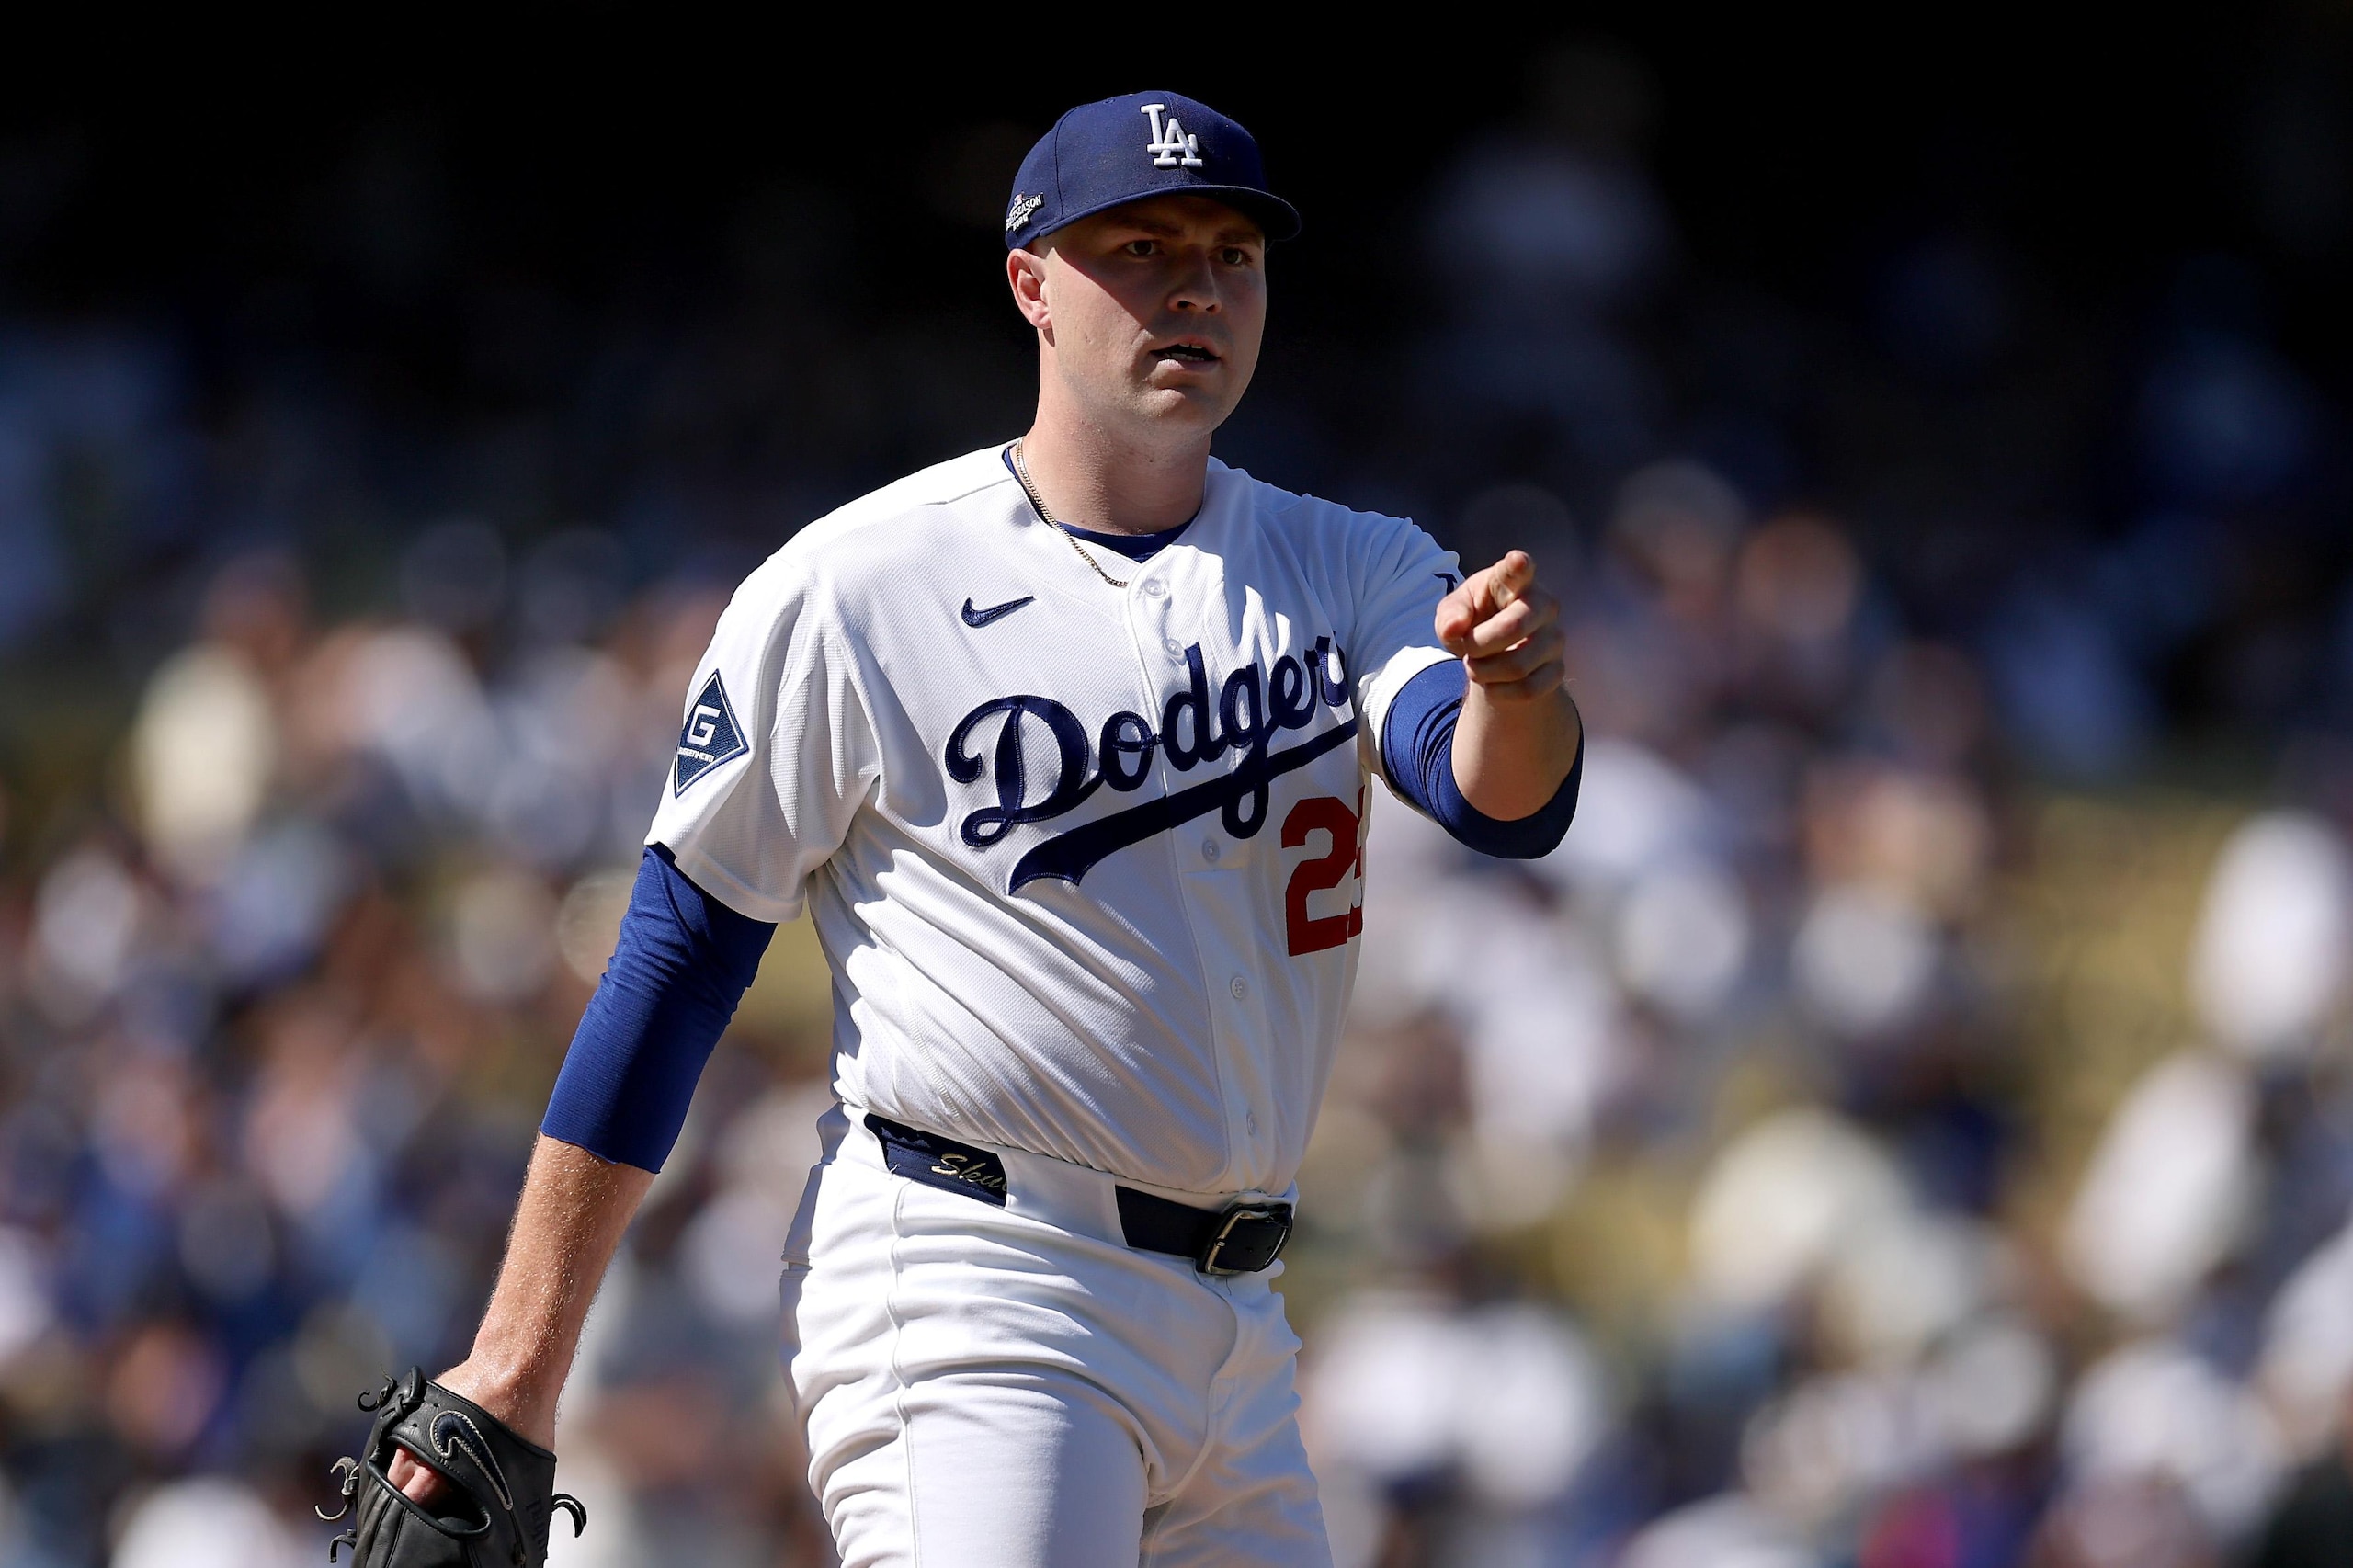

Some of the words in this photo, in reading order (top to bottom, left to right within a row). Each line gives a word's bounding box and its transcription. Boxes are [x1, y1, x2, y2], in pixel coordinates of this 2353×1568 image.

[1140, 103, 1203, 167] LA
[687, 704, 721, 746] G
[945, 631, 1351, 847] Dodger
[1280, 784, 1365, 957] 2
[931, 1153, 1007, 1192] Sku
